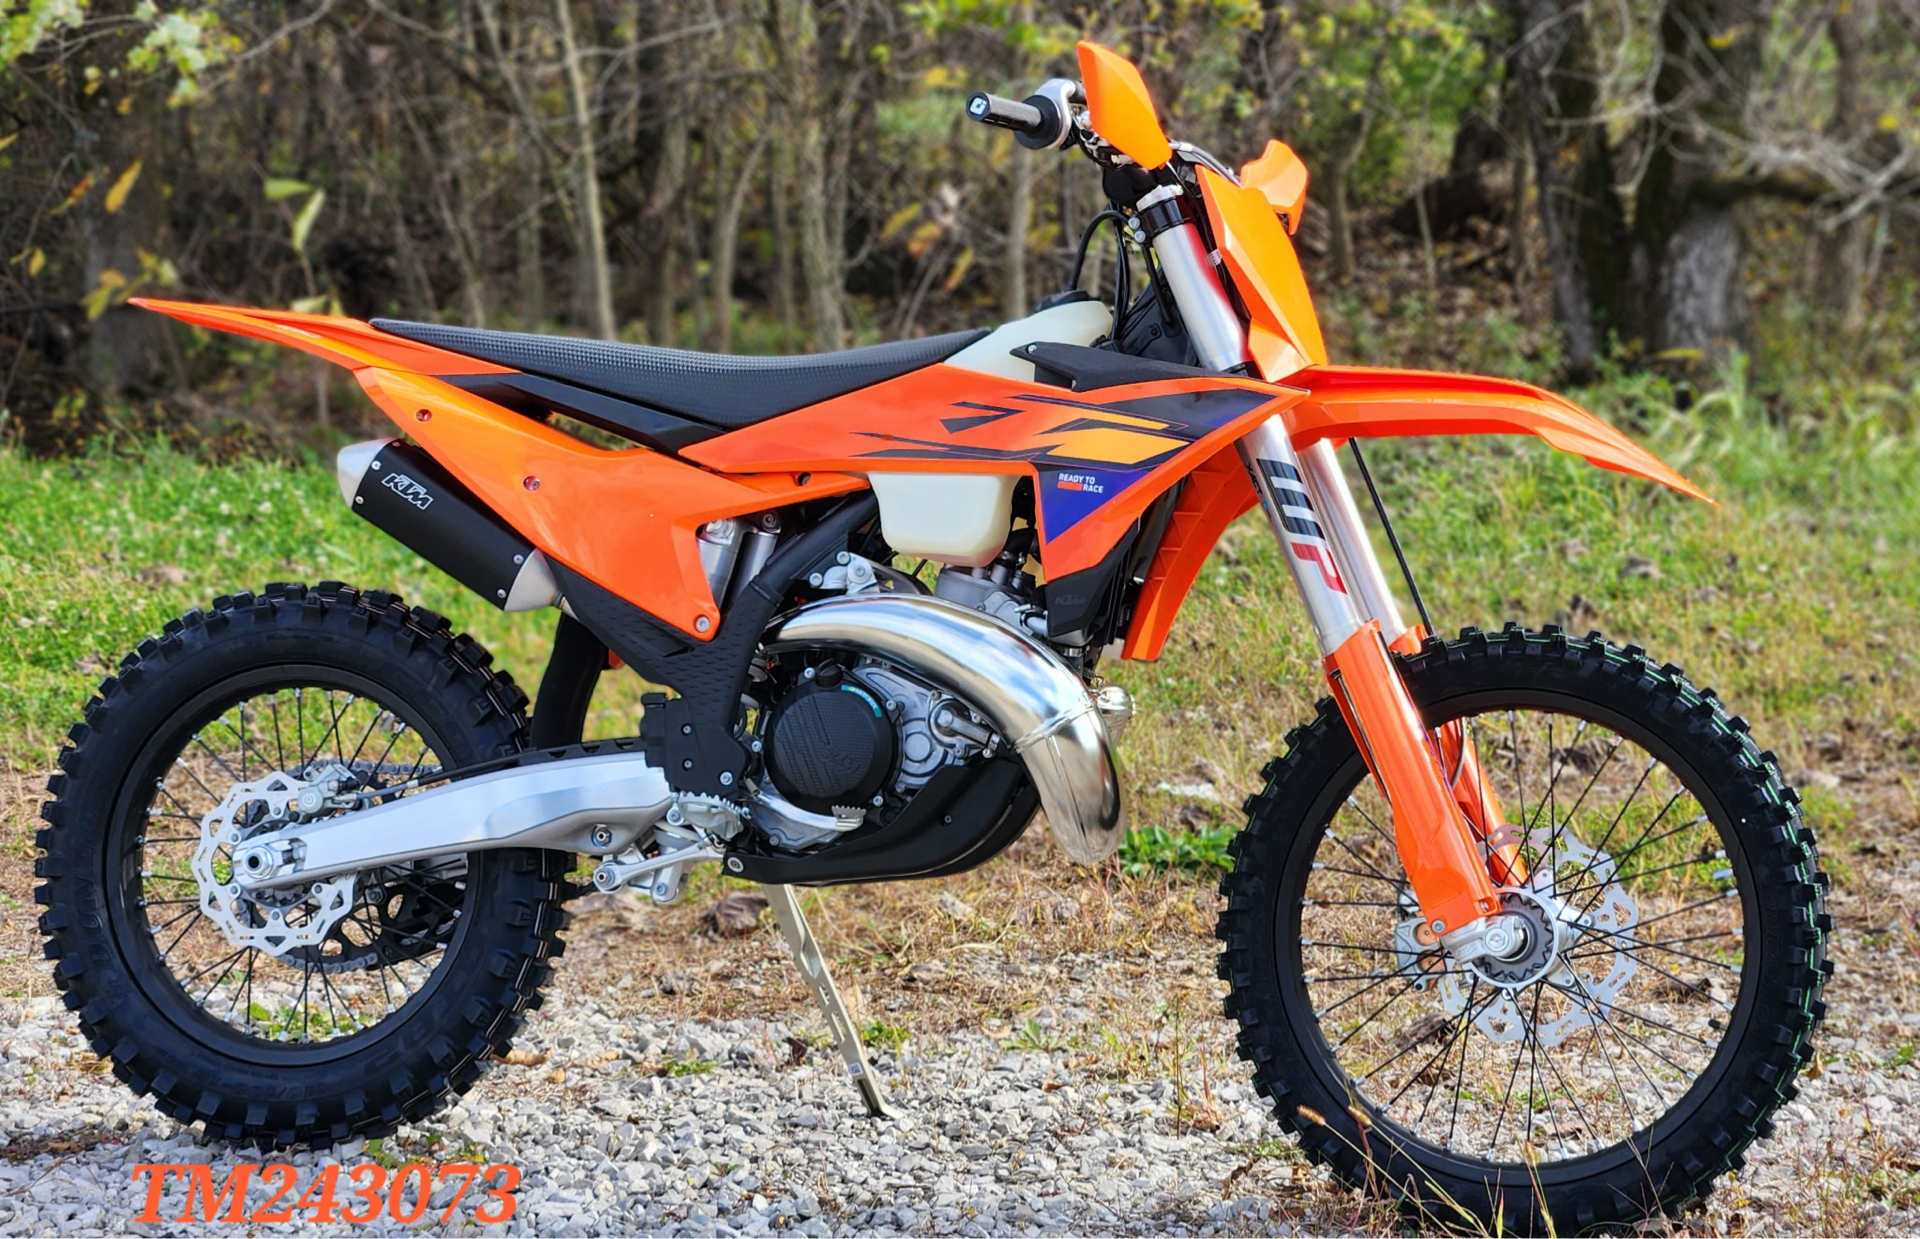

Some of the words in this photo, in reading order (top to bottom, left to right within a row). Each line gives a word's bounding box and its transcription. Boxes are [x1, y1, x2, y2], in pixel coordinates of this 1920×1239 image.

[1058, 473, 1084, 484] READY
[1085, 476, 1096, 485] TO
[381, 473, 434, 510] KTM
[1083, 484, 1104, 494] RACE
